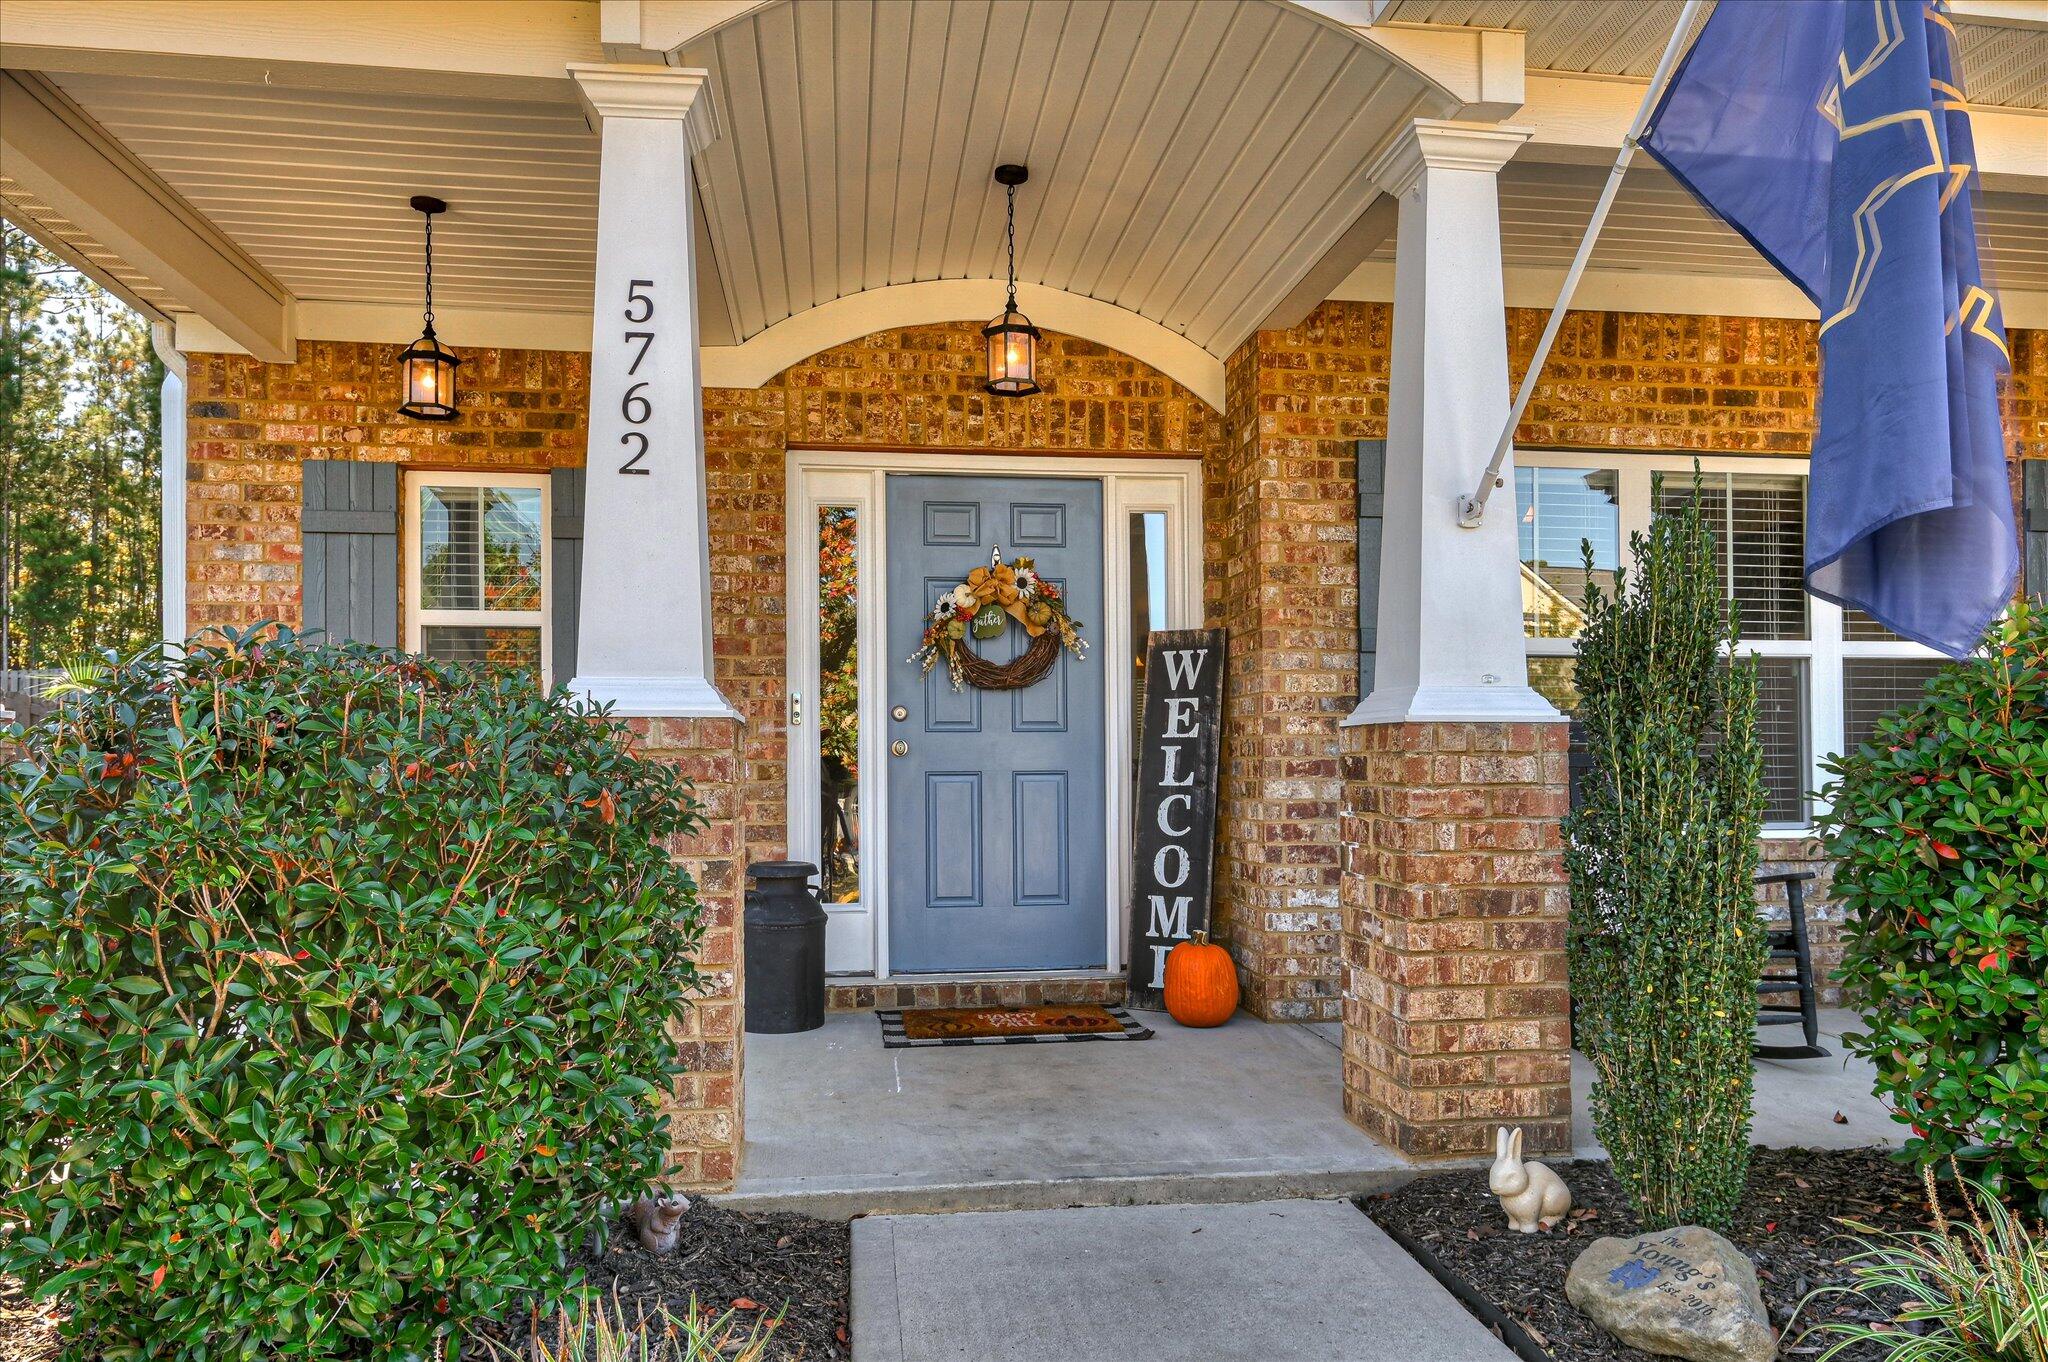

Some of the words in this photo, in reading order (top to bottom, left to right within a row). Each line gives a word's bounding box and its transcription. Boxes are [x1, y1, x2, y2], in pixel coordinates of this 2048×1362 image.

[619, 279, 655, 475] 5762
[973, 611, 1003, 632] gather
[1660, 1236, 1686, 1248] The
[1628, 1241, 1717, 1290] Young's
[1656, 1281, 1681, 1298] Est.
[1681, 1293, 1718, 1316] 2016
